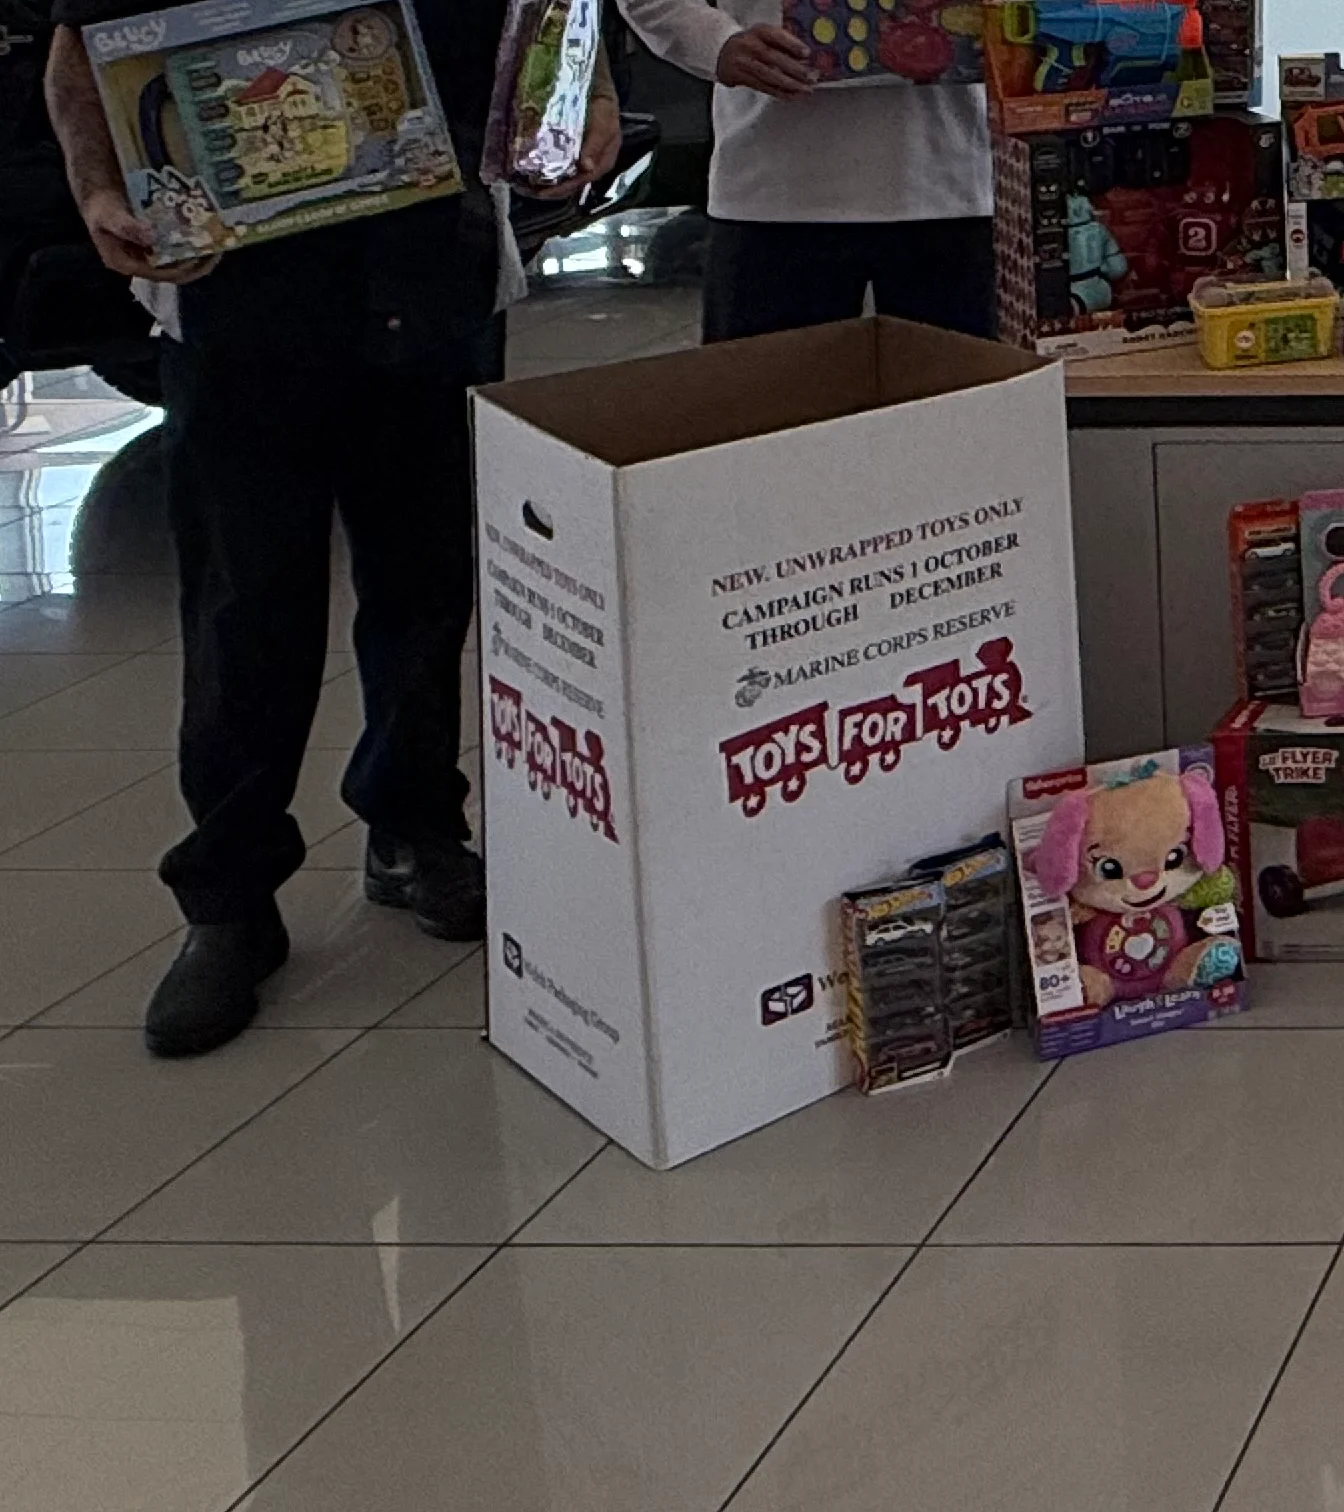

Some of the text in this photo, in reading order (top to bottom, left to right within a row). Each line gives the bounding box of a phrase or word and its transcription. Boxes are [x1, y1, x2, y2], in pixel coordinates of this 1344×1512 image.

[721, 532, 1021, 630] CAMPAIGN RUNS 1 OCTOBER
[776, 528, 913, 579] UNWRAPPED
[915, 511, 971, 541] TOYS
[974, 496, 1025, 526] ONLY
[745, 562, 1004, 650] THROUGH DECEMBER
[773, 600, 1016, 688] MARINE CORPS RESERVE
[491, 692, 605, 816] TOYS FOR TOTS
[730, 672, 1012, 786] TOYS FOR TOTS
[1281, 749, 1334, 766] FLYER
[1272, 766, 1324, 781] TRIKE
